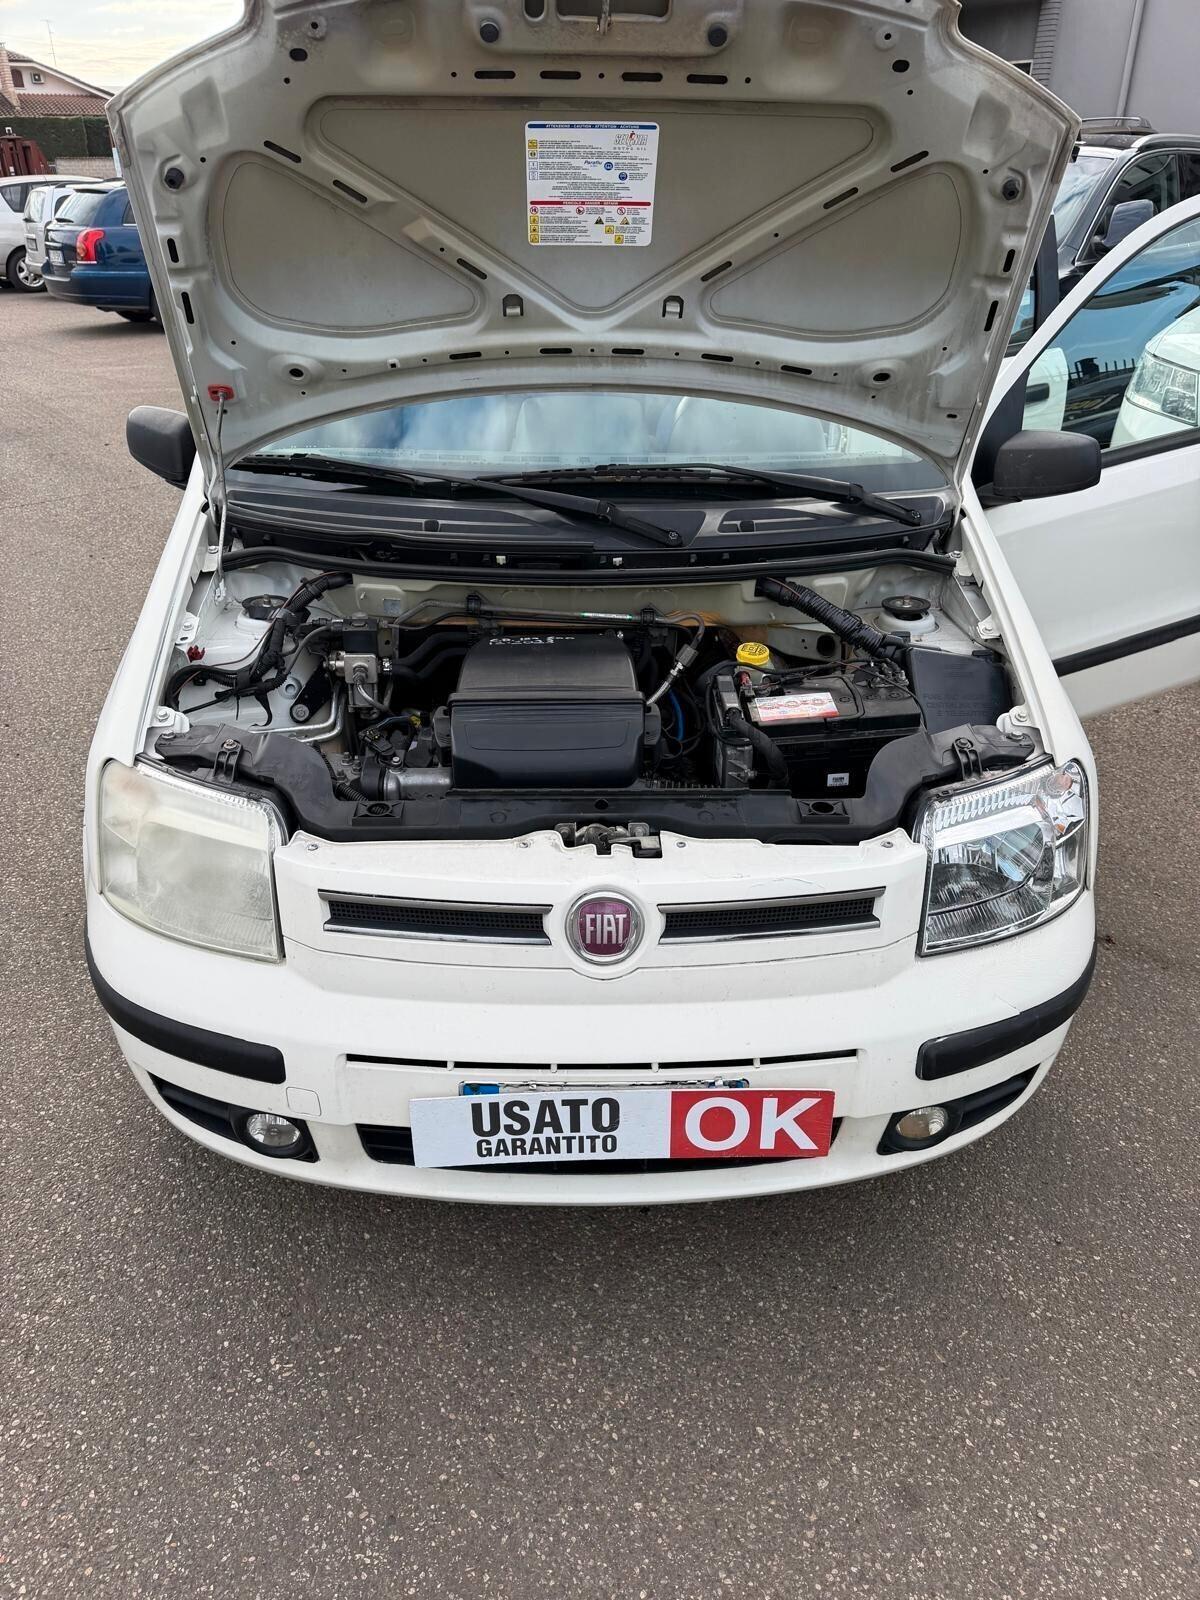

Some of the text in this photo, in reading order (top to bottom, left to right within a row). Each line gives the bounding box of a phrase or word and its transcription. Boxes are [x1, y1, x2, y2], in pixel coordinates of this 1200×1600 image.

[585, 913, 627, 945] FIAT
[471, 1097, 621, 1137] USATO
[684, 1096, 823, 1152] OK
[476, 1134, 618, 1158] GARANTITO
